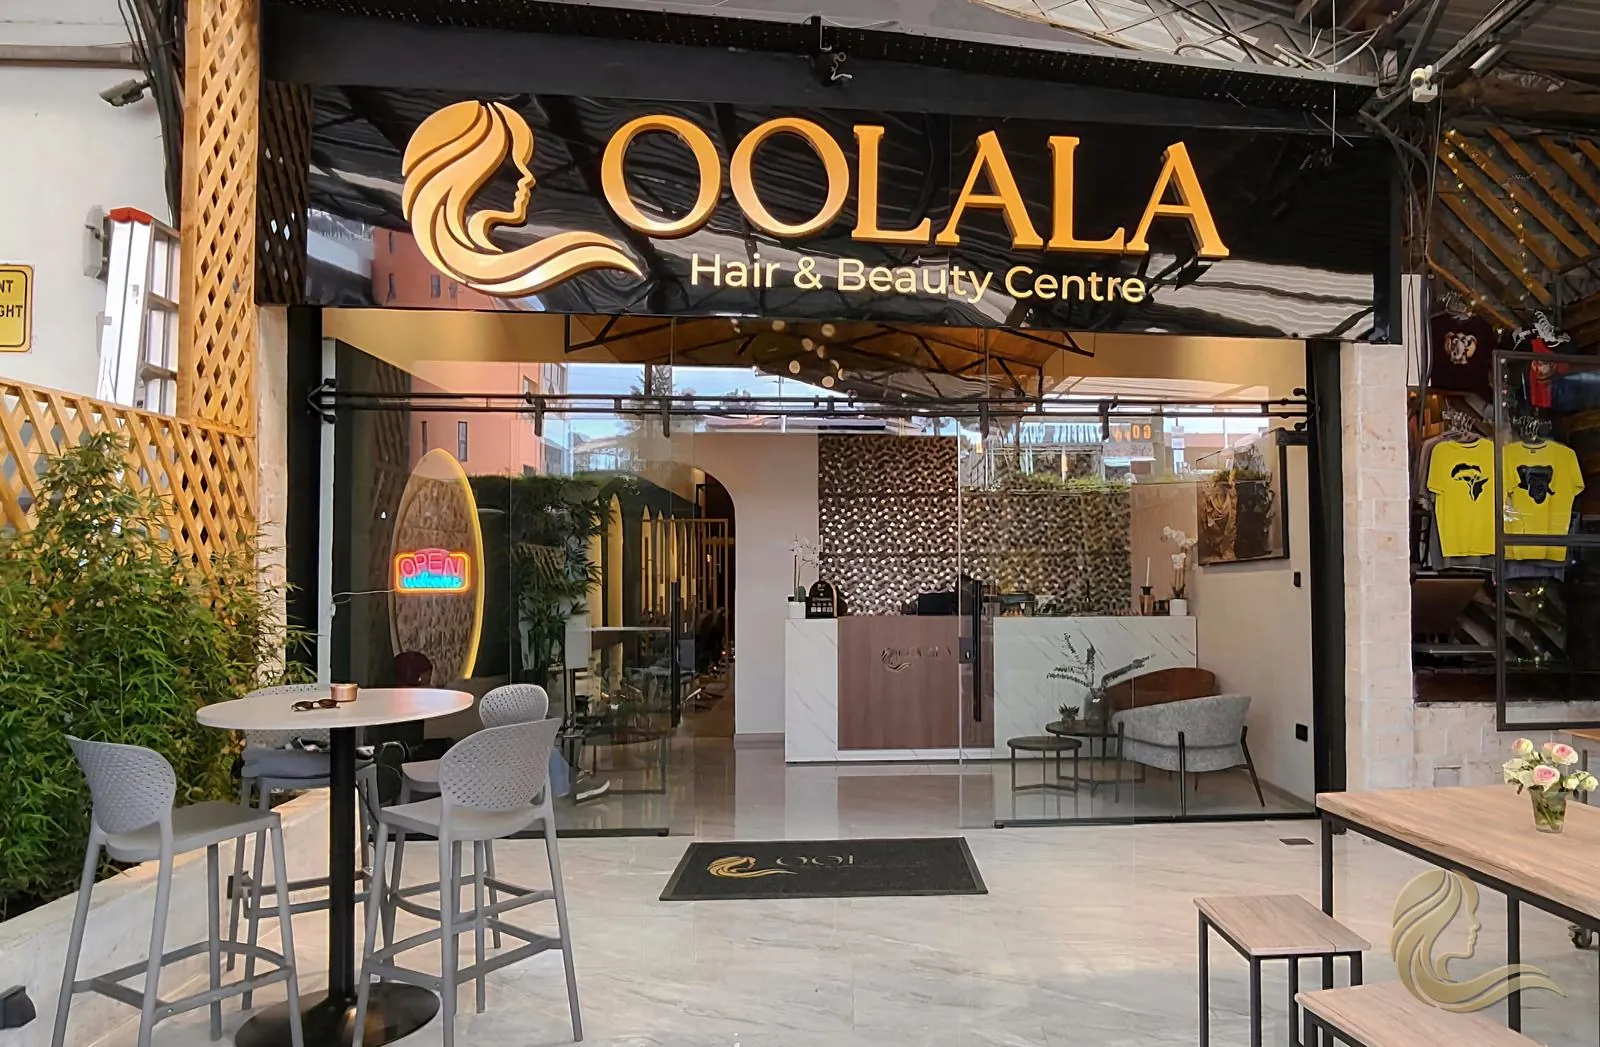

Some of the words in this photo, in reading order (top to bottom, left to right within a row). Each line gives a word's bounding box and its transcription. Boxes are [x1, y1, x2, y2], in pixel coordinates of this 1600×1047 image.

[601, 114, 1230, 257] OOLALA
[690, 252, 780, 288] Hair
[793, 256, 823, 290] &
[837, 258, 993, 304] Beauty
[1004, 266, 1146, 303] Centre
[400, 553, 462, 577] OPEN
